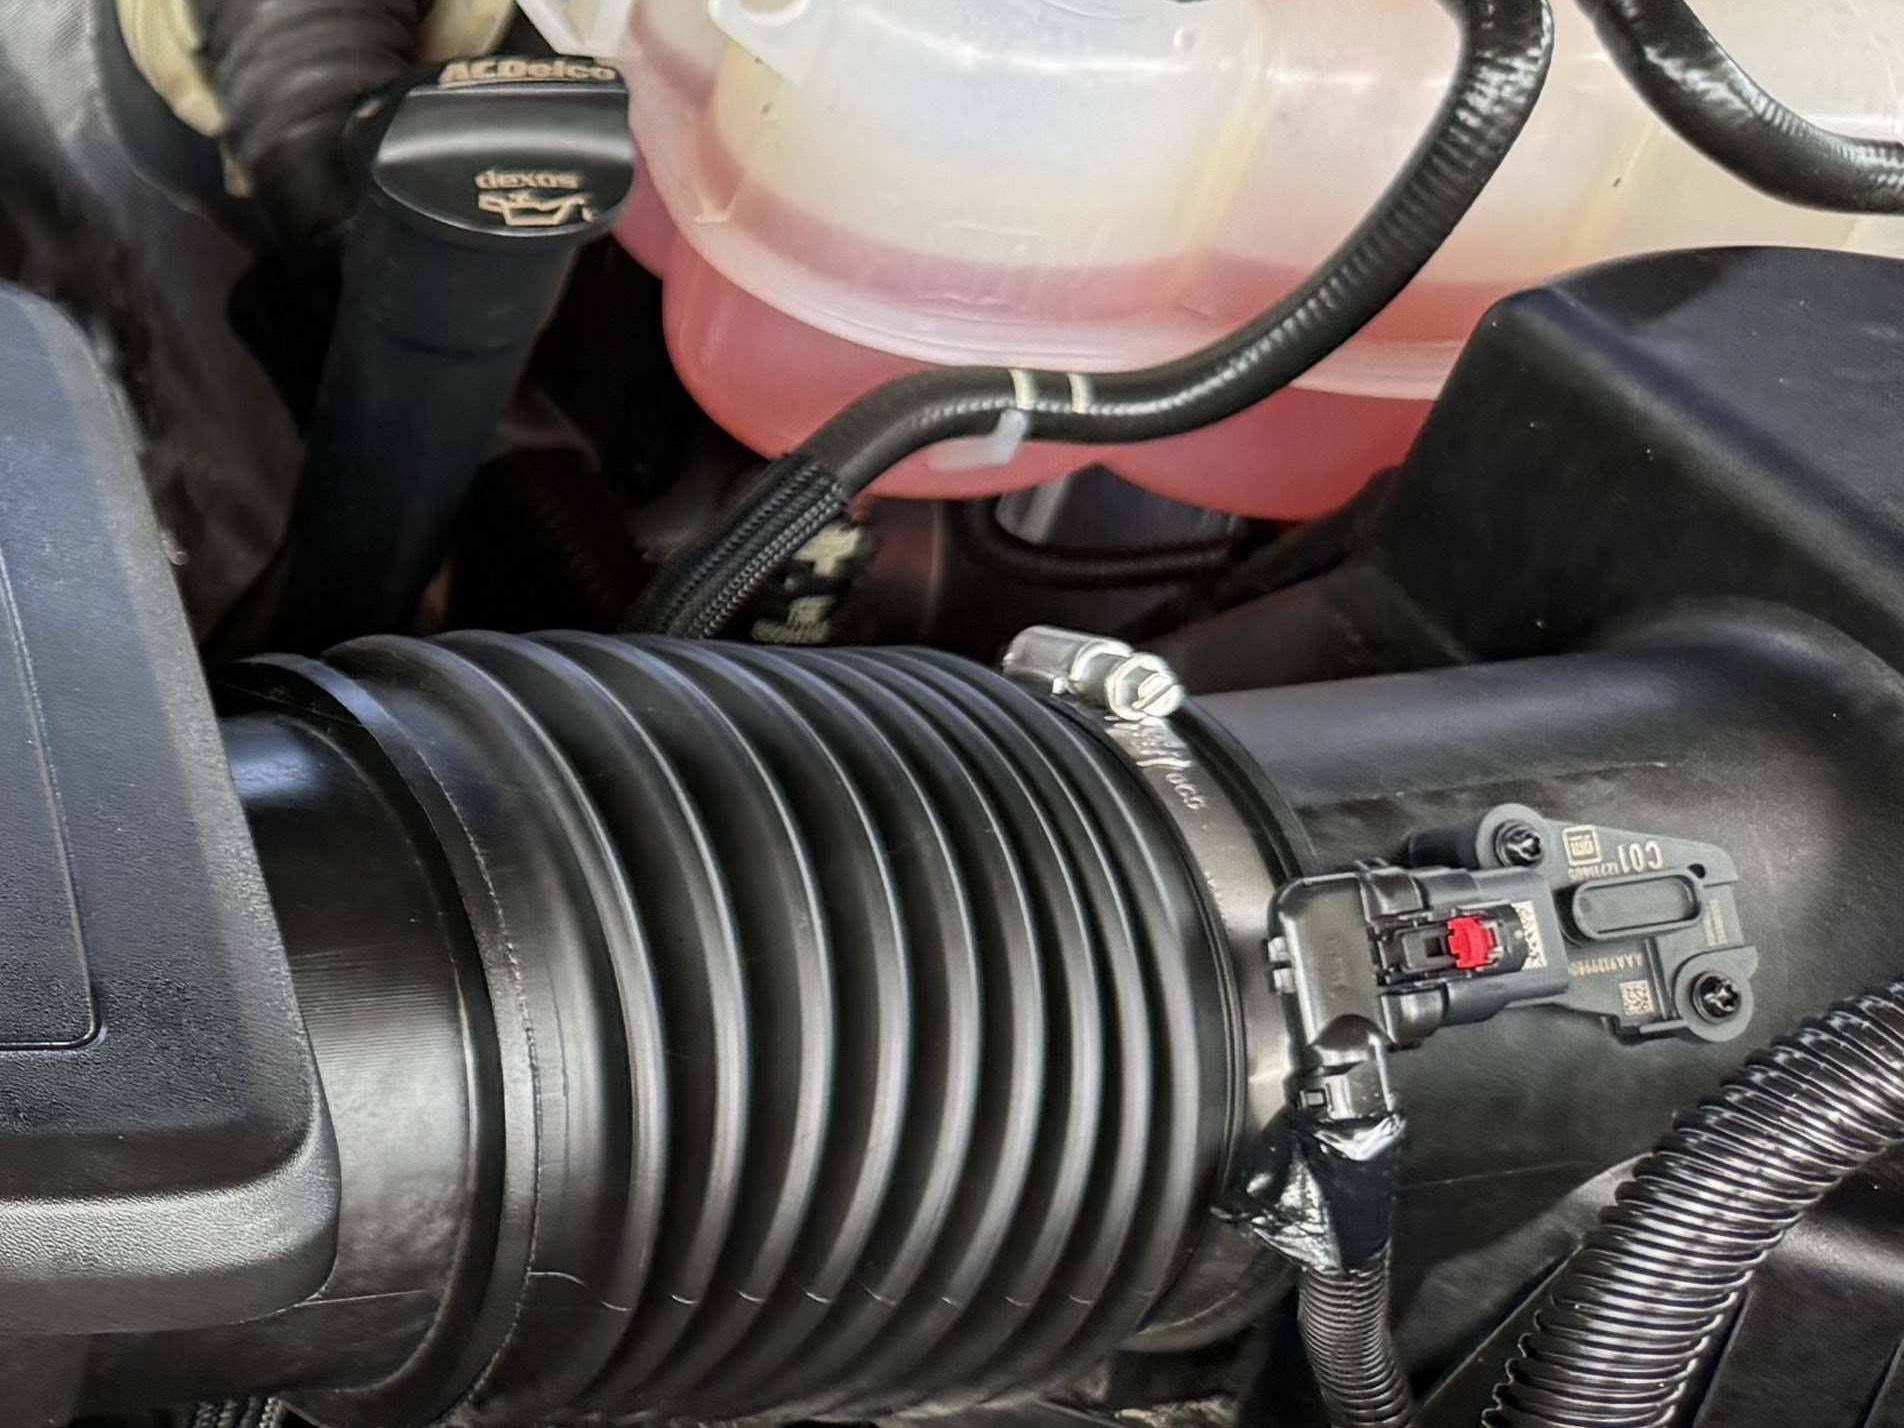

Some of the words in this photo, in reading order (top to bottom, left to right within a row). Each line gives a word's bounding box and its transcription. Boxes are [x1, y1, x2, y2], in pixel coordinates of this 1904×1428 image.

[438, 60, 616, 84] ACDelco
[475, 169, 581, 189] dexos
[1617, 840, 1664, 874] C01
